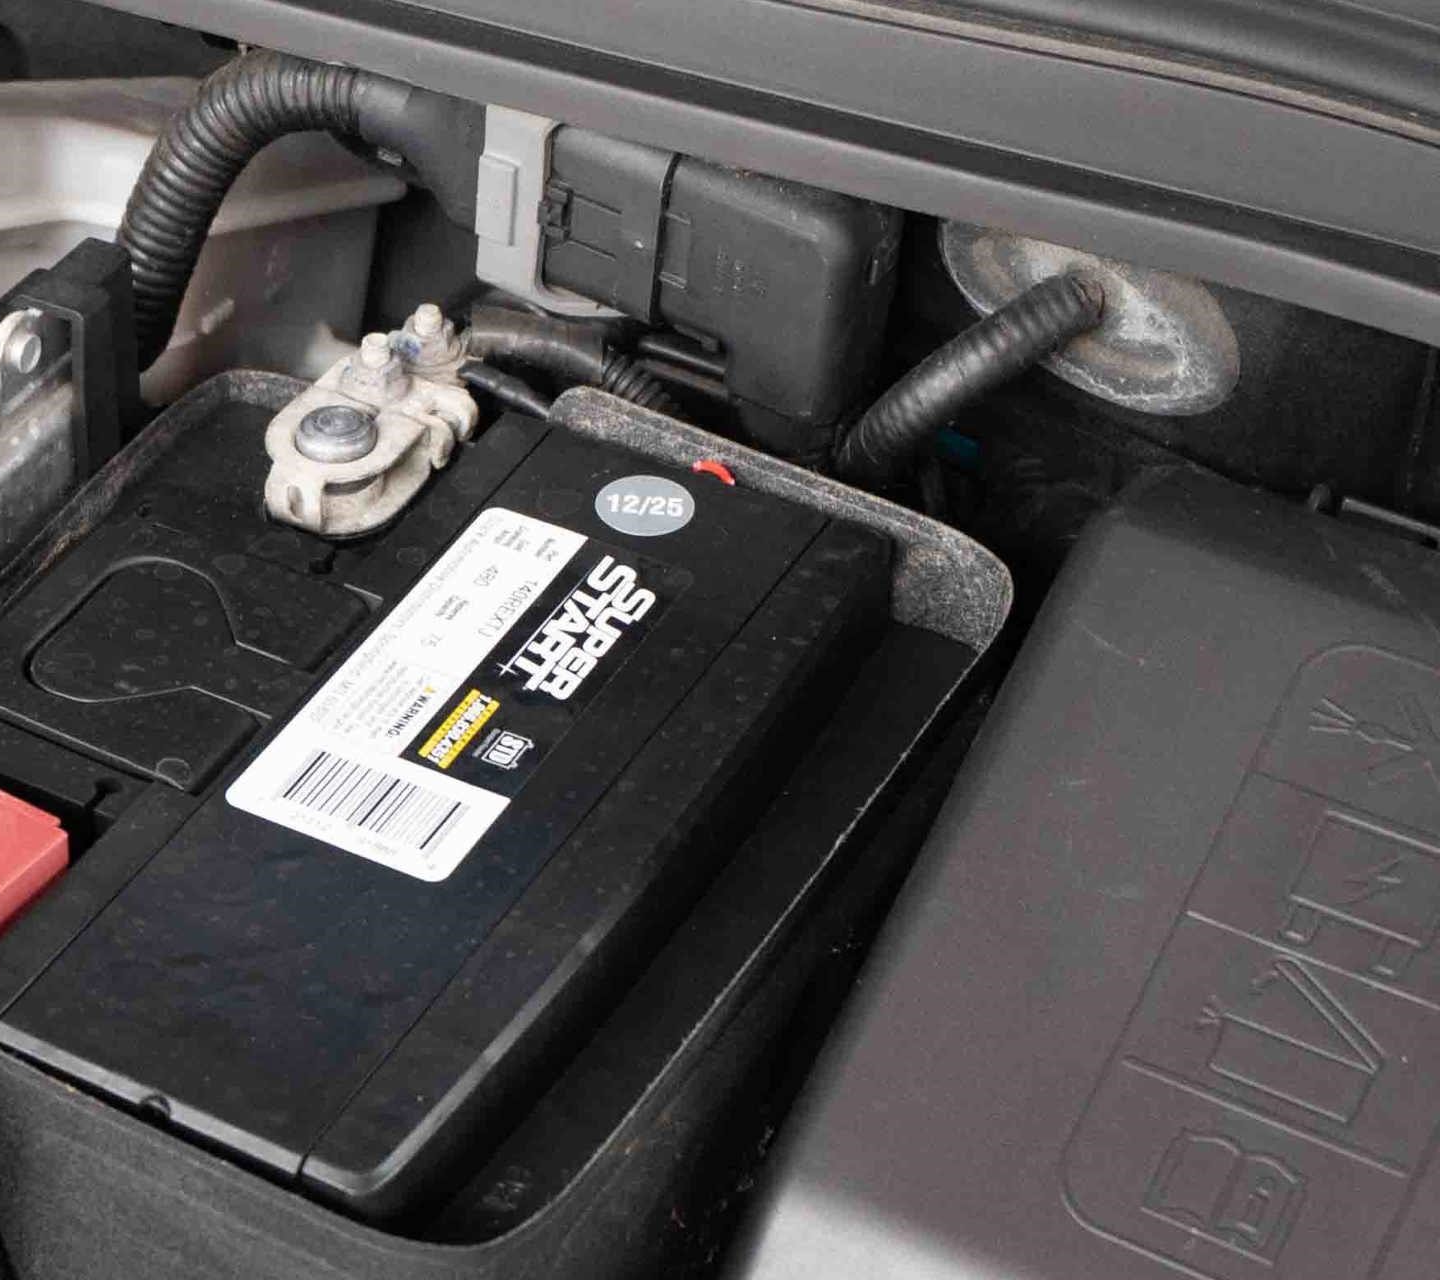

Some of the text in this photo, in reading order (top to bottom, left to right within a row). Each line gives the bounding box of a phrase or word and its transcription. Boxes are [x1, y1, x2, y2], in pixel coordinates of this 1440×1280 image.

[606, 493, 683, 517] 12/25
[512, 555, 637, 692] START
[538, 580, 656, 700] SUPER
